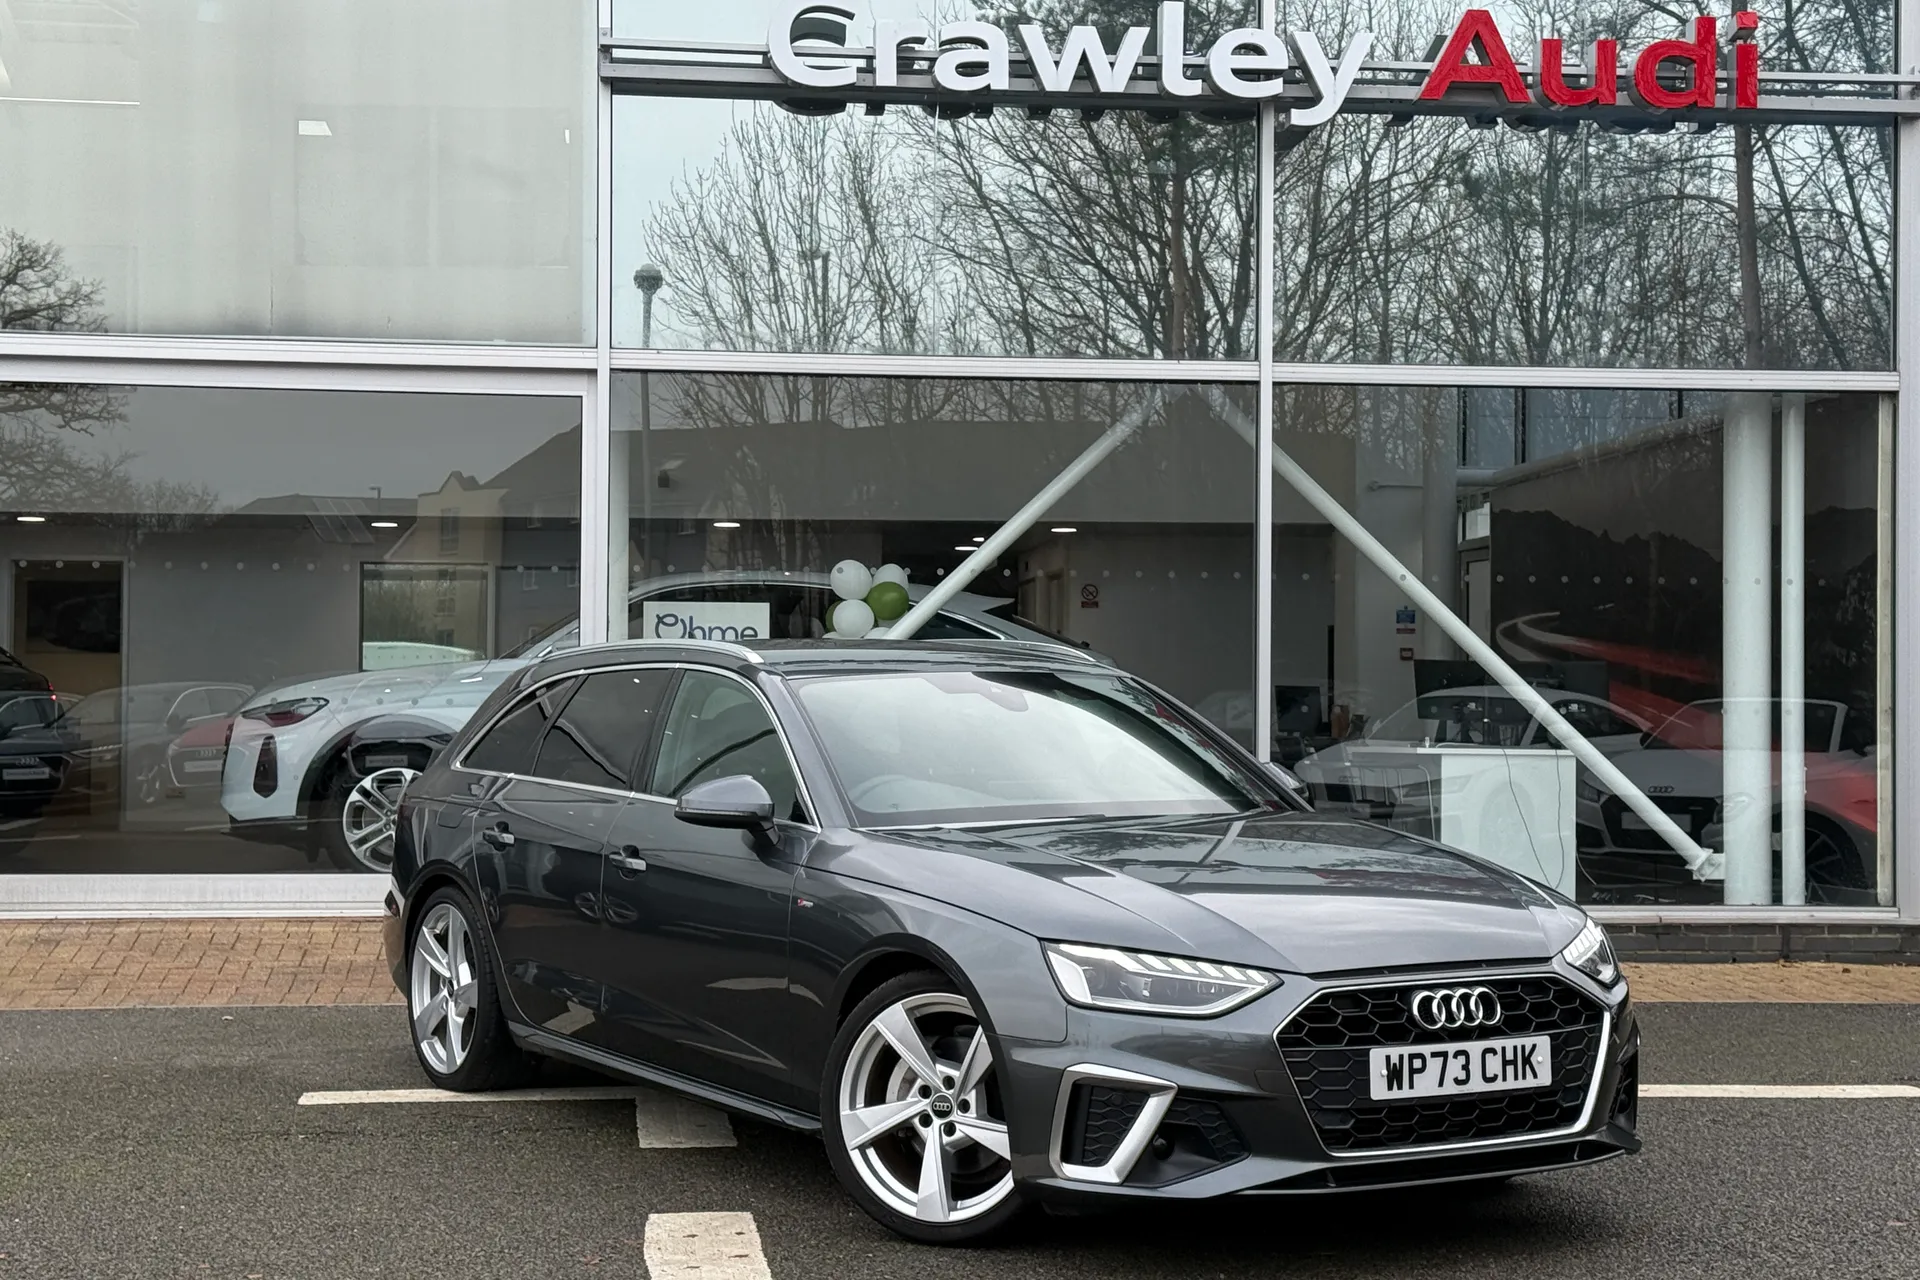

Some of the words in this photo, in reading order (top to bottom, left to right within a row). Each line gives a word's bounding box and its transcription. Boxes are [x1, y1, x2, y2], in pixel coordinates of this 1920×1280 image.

[767, 0, 1375, 126] Crawley
[1417, 9, 1759, 110] Audi
[654, 612, 759, 640] Ohme
[1385, 1049, 1471, 1092] WP73
[1481, 1043, 1538, 1084] CHK
